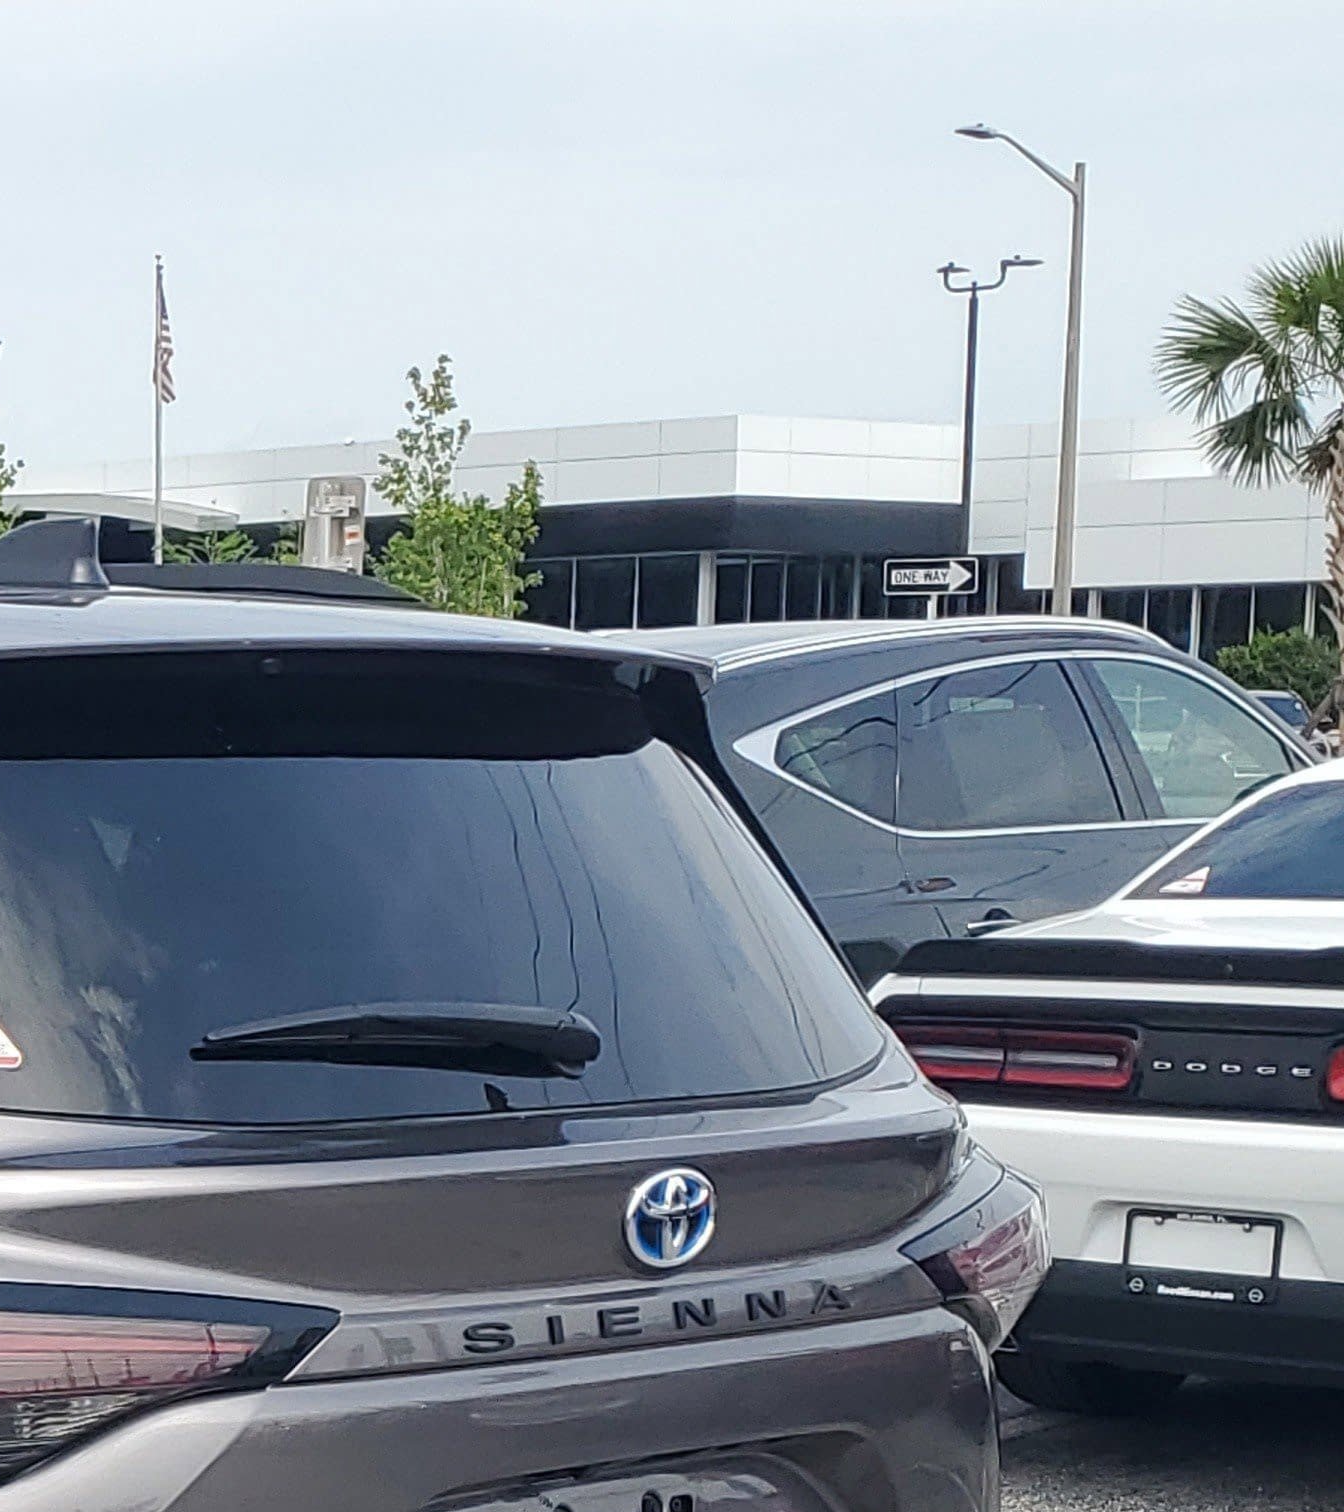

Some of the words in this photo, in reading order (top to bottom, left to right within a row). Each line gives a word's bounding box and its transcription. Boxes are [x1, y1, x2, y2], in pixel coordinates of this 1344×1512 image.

[894, 571, 918, 584] ONE
[923, 570, 949, 582] WAY
[1152, 1059, 1312, 1078] DODGE
[462, 1282, 852, 1354] SIENNA
